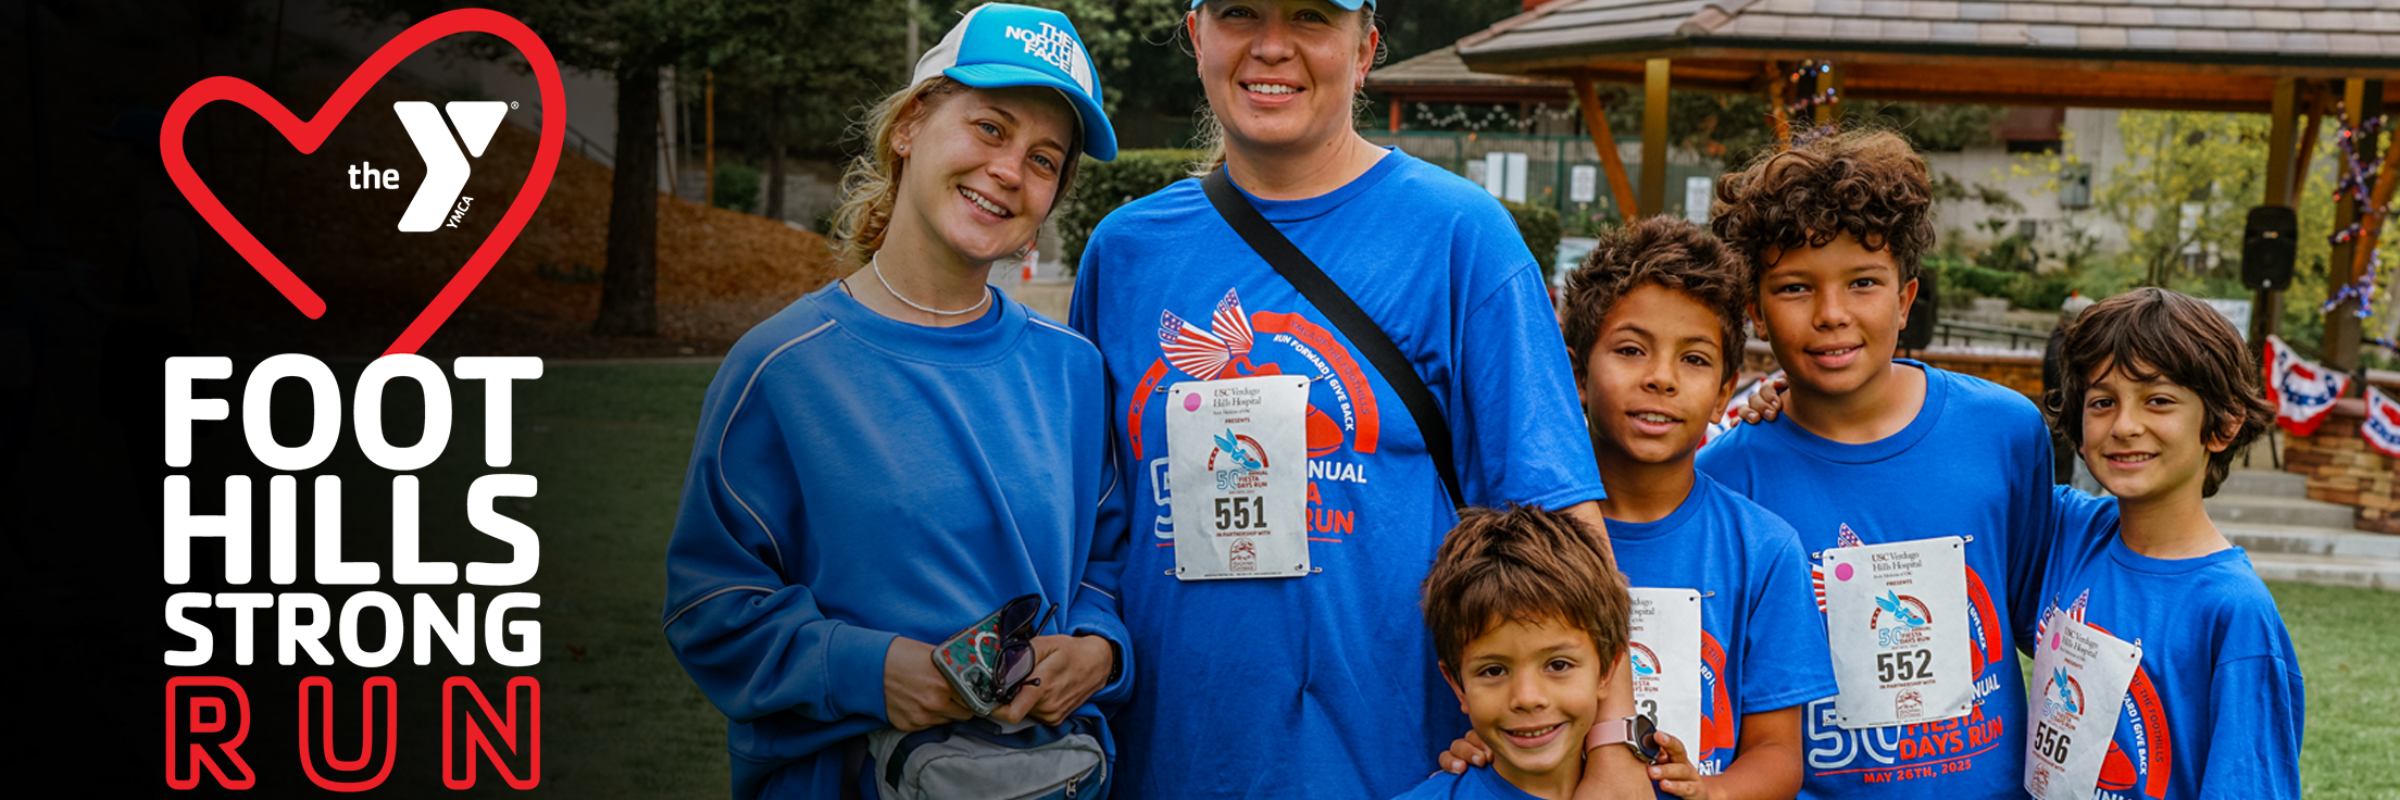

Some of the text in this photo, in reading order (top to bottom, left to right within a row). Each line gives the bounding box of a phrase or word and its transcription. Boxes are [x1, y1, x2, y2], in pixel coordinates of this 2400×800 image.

[1005, 25, 1074, 66] NORTH
[1038, 22, 1074, 49] THE
[1024, 41, 1072, 75] FACE
[1273, 334, 1292, 344] RUN
[1290, 339, 1330, 375] FORWARD
[1329, 378, 1348, 402] GIVE
[1340, 402, 1354, 431] BACK
[1291, 320, 1371, 415] YMCA OF THE FOOTHILLS
[1308, 459, 1367, 483] NUAL
[1214, 496, 1268, 530] 551
[1969, 607, 1982, 627] GIVE
[1977, 626, 1987, 651] BACK
[1877, 648, 1933, 683] 552
[1972, 673, 2000, 700] NUAL
[1899, 716, 2003, 760] DAYS RUN
[2034, 720, 2072, 764] 556
[2133, 723, 2145, 747] GIVE
[2140, 688, 2152, 708] THE
[2148, 708, 2164, 763] FOOTHILLS
[1864, 759, 1971, 783] MAY 26TH, 2025
[2138, 748, 2147, 775] BACK
